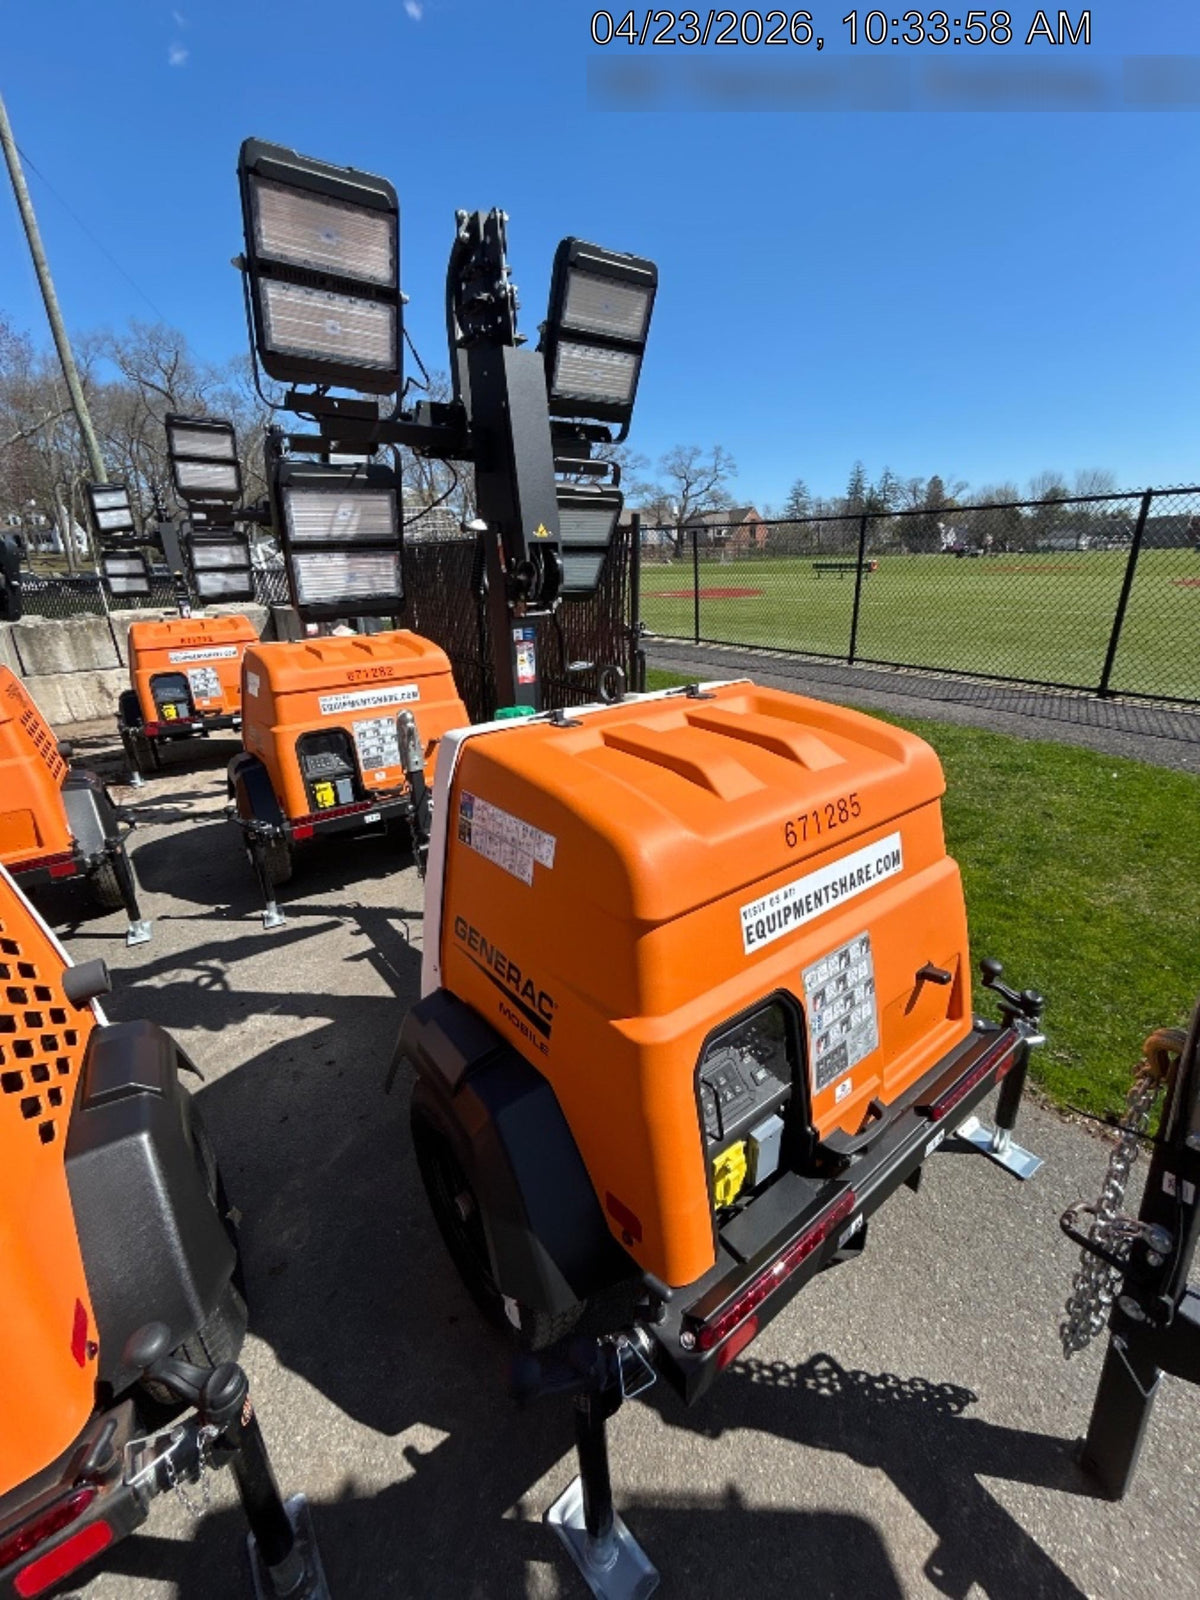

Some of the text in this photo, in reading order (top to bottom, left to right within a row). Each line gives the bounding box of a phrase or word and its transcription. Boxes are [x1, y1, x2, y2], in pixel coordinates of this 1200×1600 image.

[784, 793, 862, 848] 671285
[744, 849, 901, 946] EQUIPMENTSHARE.COM
[454, 915, 554, 1021] GENERAC
[499, 1002, 549, 1056] MOBILE
